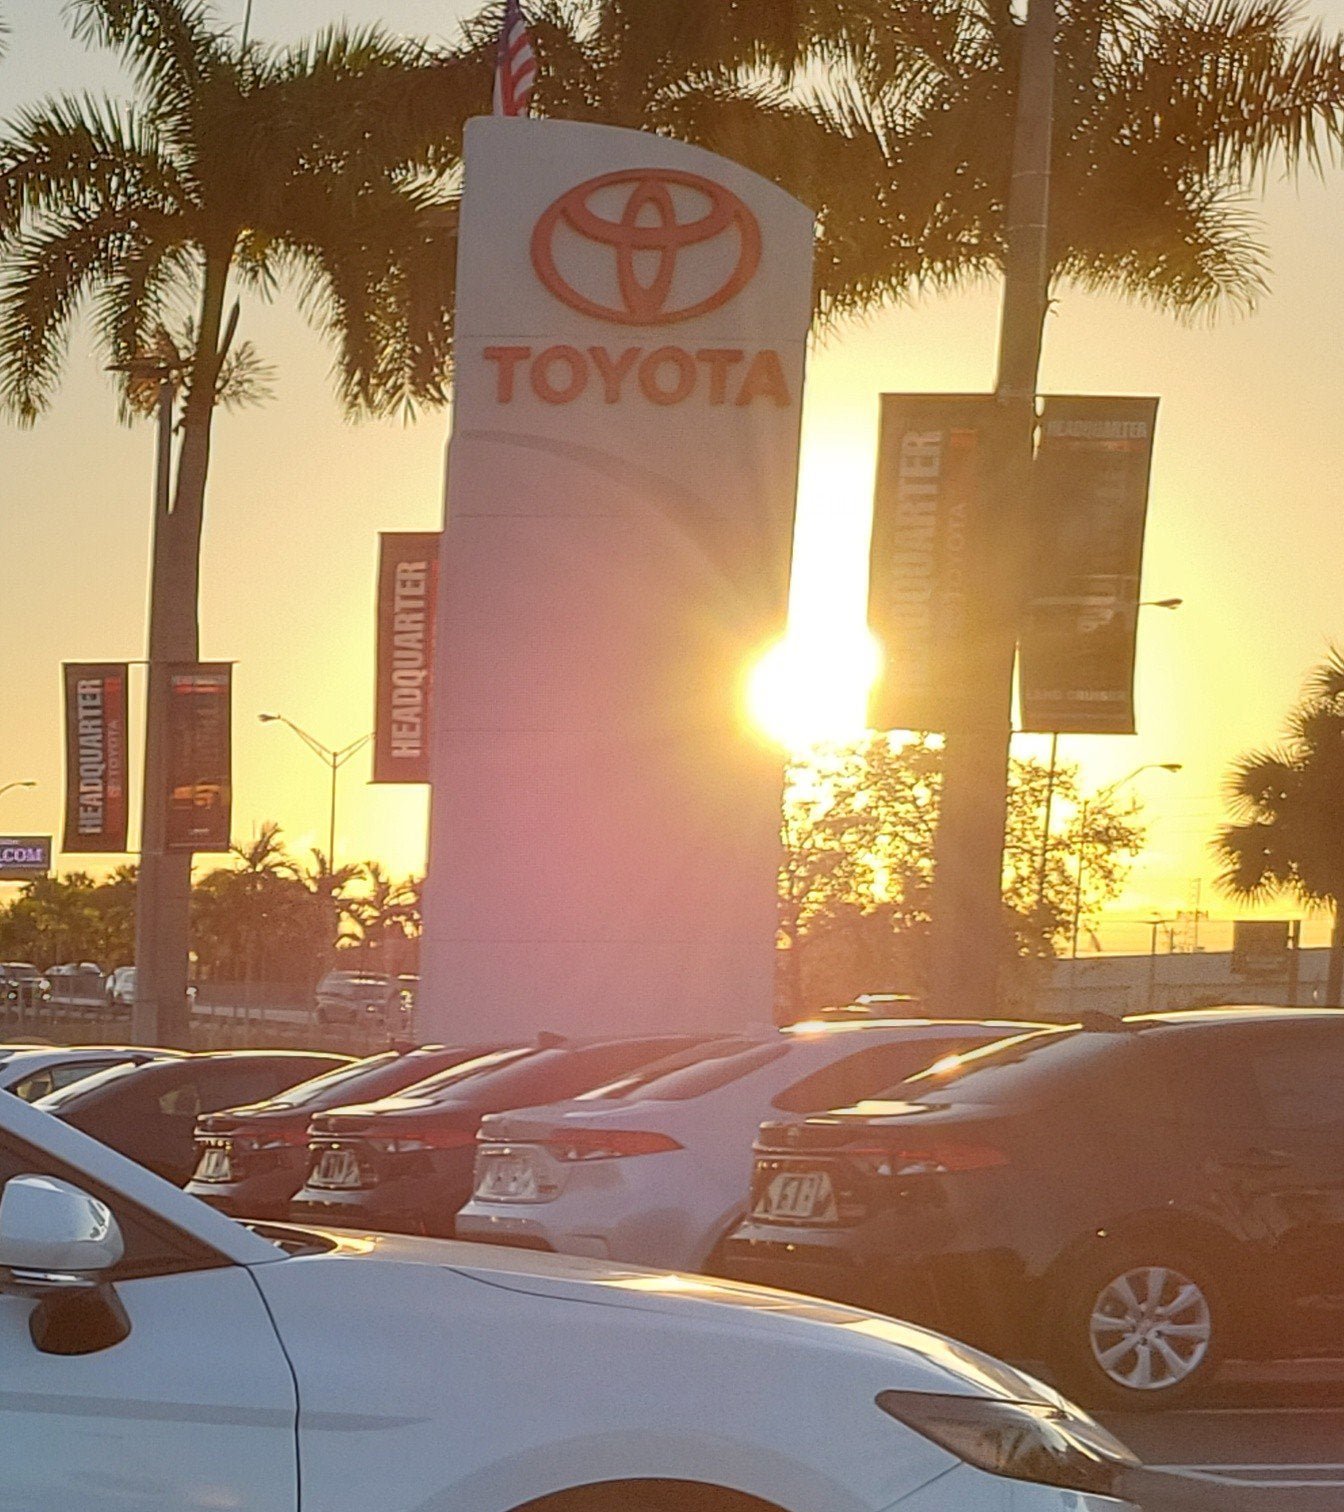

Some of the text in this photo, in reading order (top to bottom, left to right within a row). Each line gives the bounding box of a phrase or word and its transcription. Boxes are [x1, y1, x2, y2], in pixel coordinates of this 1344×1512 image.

[483, 345, 792, 407] TOYOTA
[391, 561, 427, 757] HEADQUARTER
[77, 679, 106, 834] HEADQUARTER
